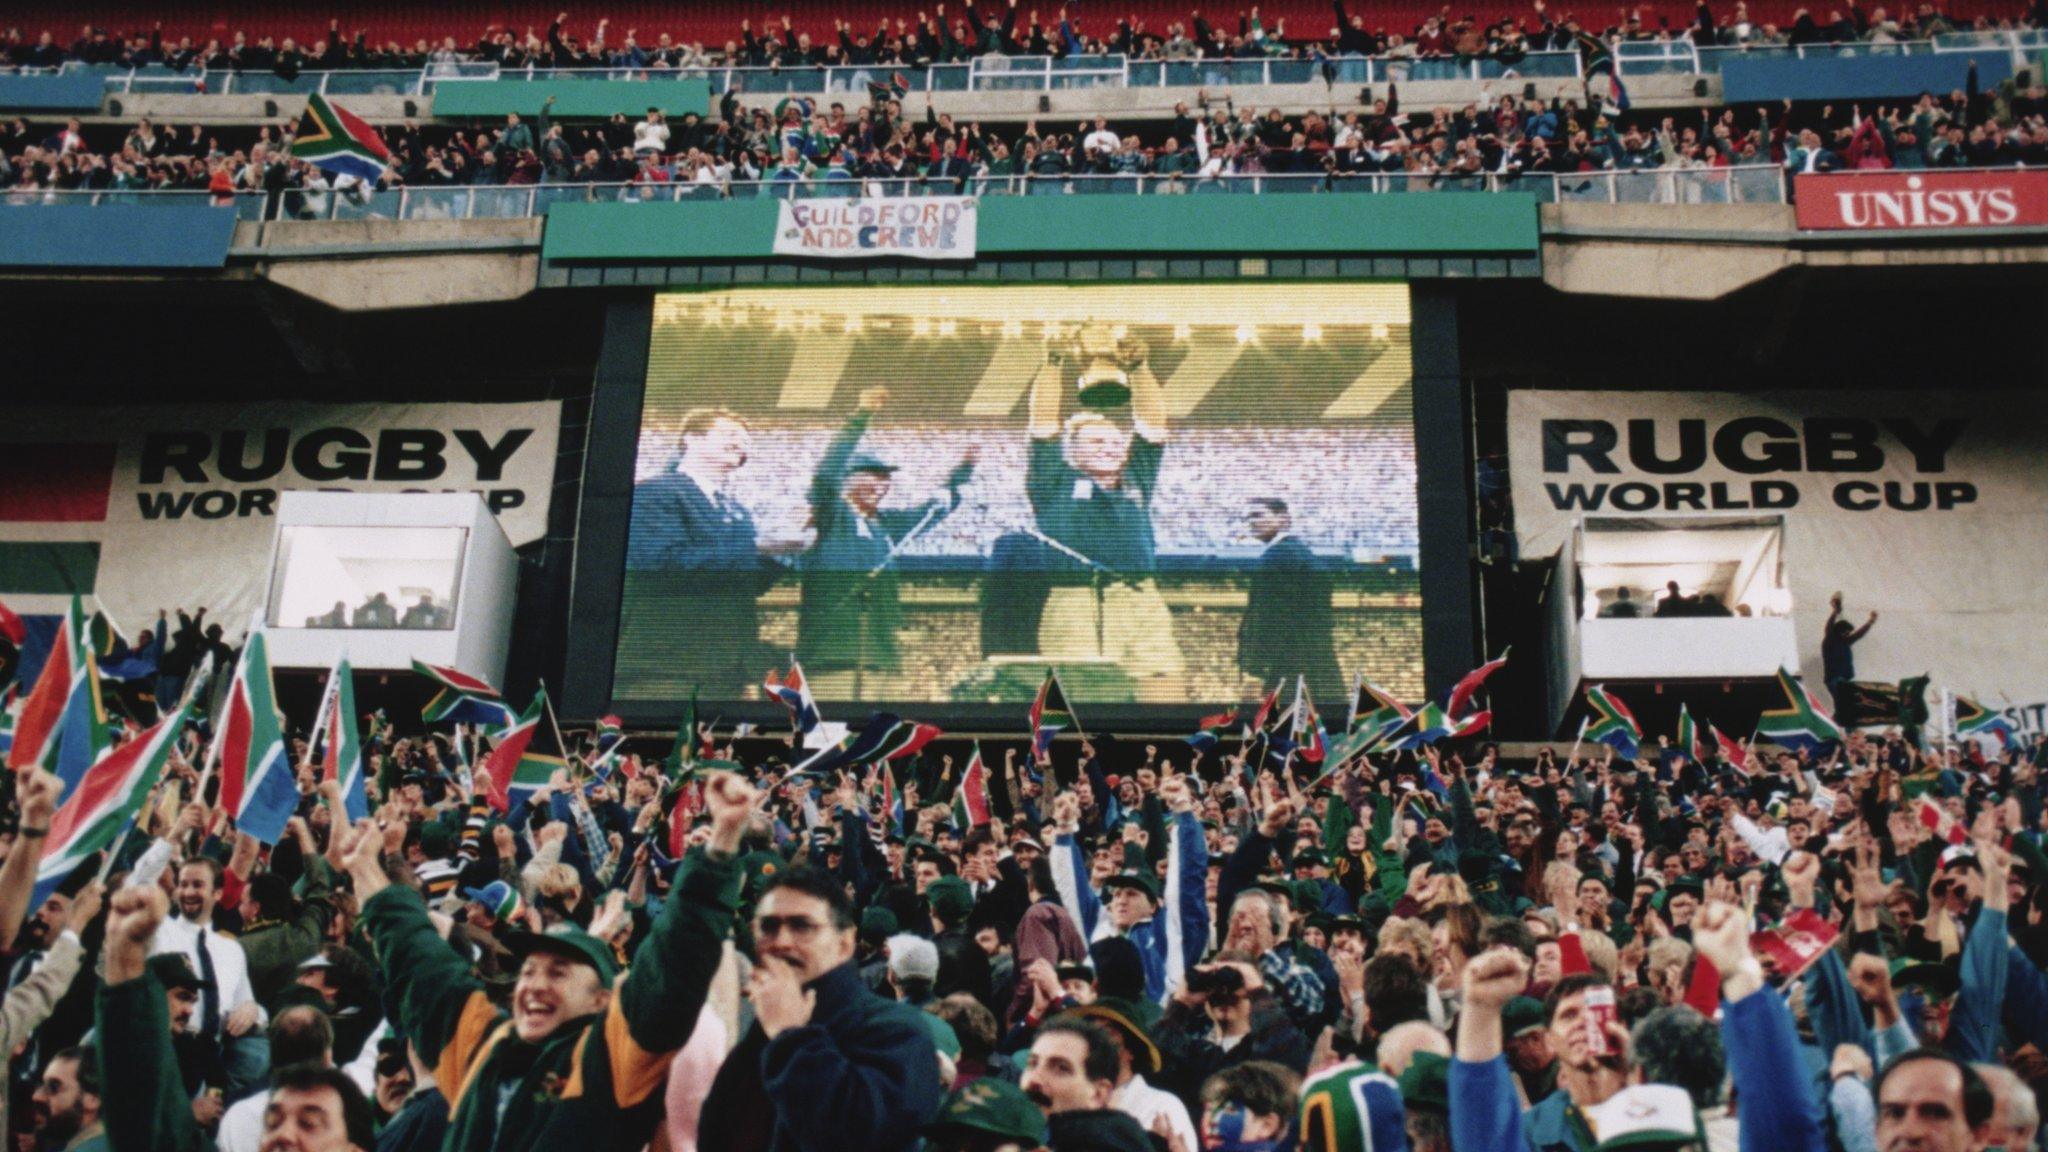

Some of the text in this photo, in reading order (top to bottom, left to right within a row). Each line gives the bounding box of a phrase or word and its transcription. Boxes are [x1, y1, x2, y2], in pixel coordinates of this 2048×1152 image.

[792, 203, 961, 228] GUILDFORD
[858, 224, 957, 249] CREWE
[139, 427, 534, 484] RUGBY
[1541, 416, 1966, 474] RUGBY
[137, 487, 355, 520] WOR
[1543, 480, 1978, 512] WORLD CUP
